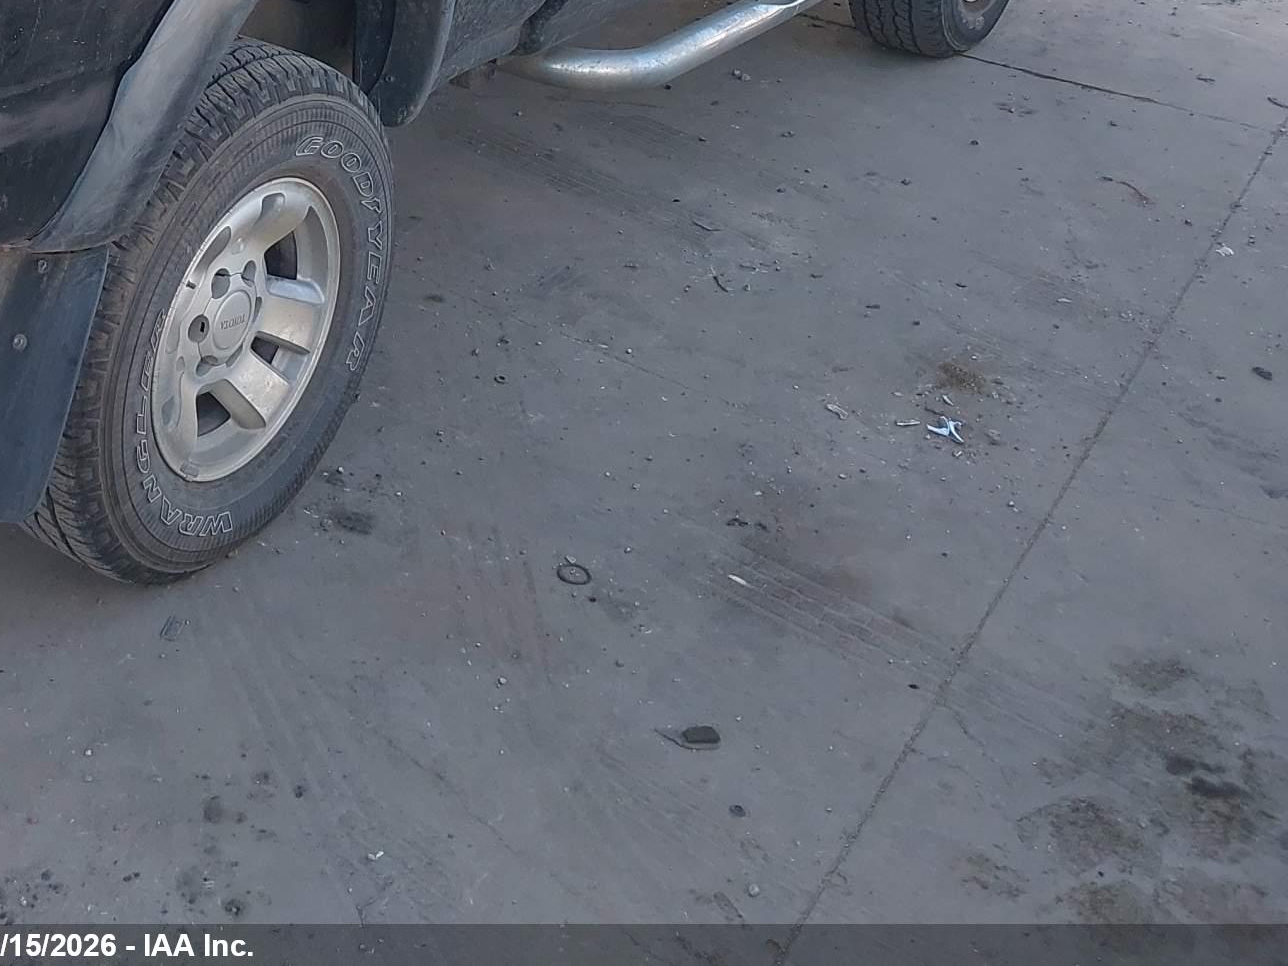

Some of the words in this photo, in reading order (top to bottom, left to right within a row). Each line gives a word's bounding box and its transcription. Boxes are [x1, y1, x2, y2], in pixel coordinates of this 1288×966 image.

[219, 313, 246, 331] TOYOTA
[295, 135, 386, 372] GOODYEAR
[134, 307, 234, 539] WRANGLER
